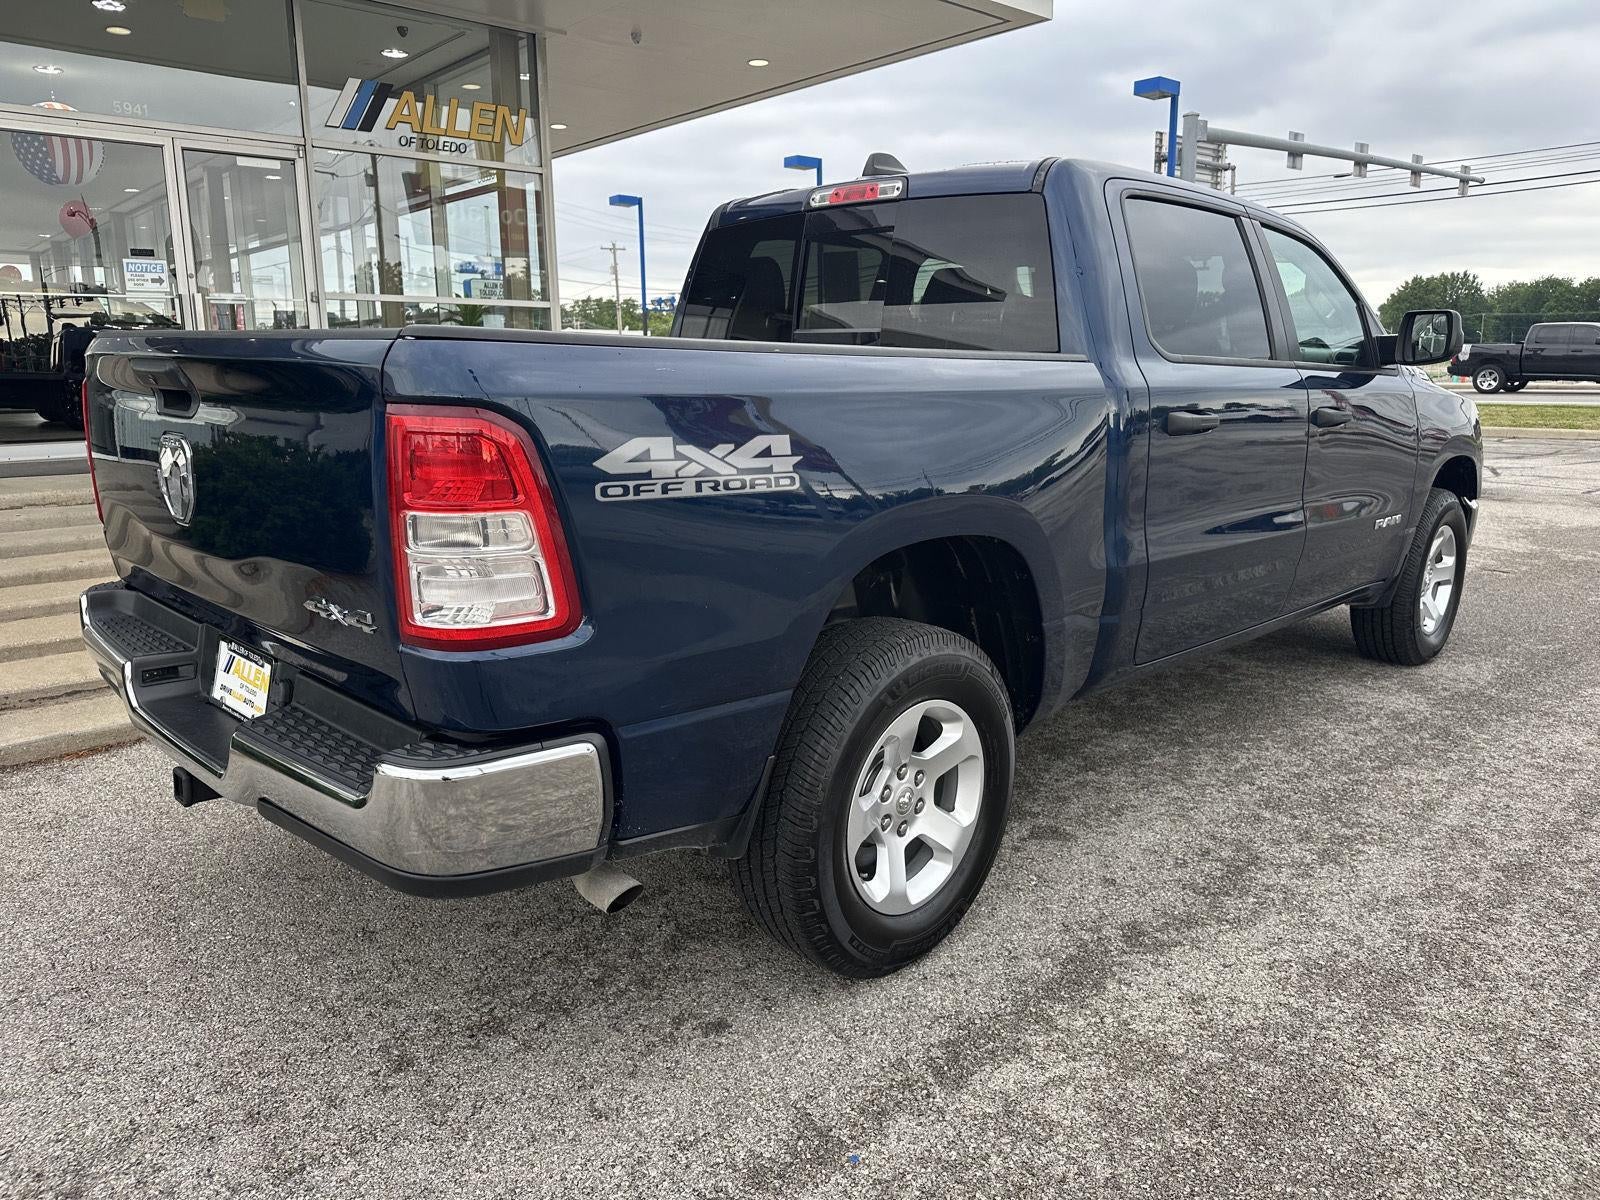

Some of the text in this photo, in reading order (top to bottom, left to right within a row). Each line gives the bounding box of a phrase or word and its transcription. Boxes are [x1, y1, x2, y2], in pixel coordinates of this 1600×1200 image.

[112, 100, 149, 118] 5941
[385, 90, 527, 146] ALLEN
[398, 135, 467, 154] OF TOLEDO
[127, 263, 163, 273] NOTICE
[600, 475, 797, 498] OFF ROAD
[1374, 514, 1402, 530] RAM
[233, 658, 270, 693] ALLEN
[245, 685, 257, 697] TOLEDO
